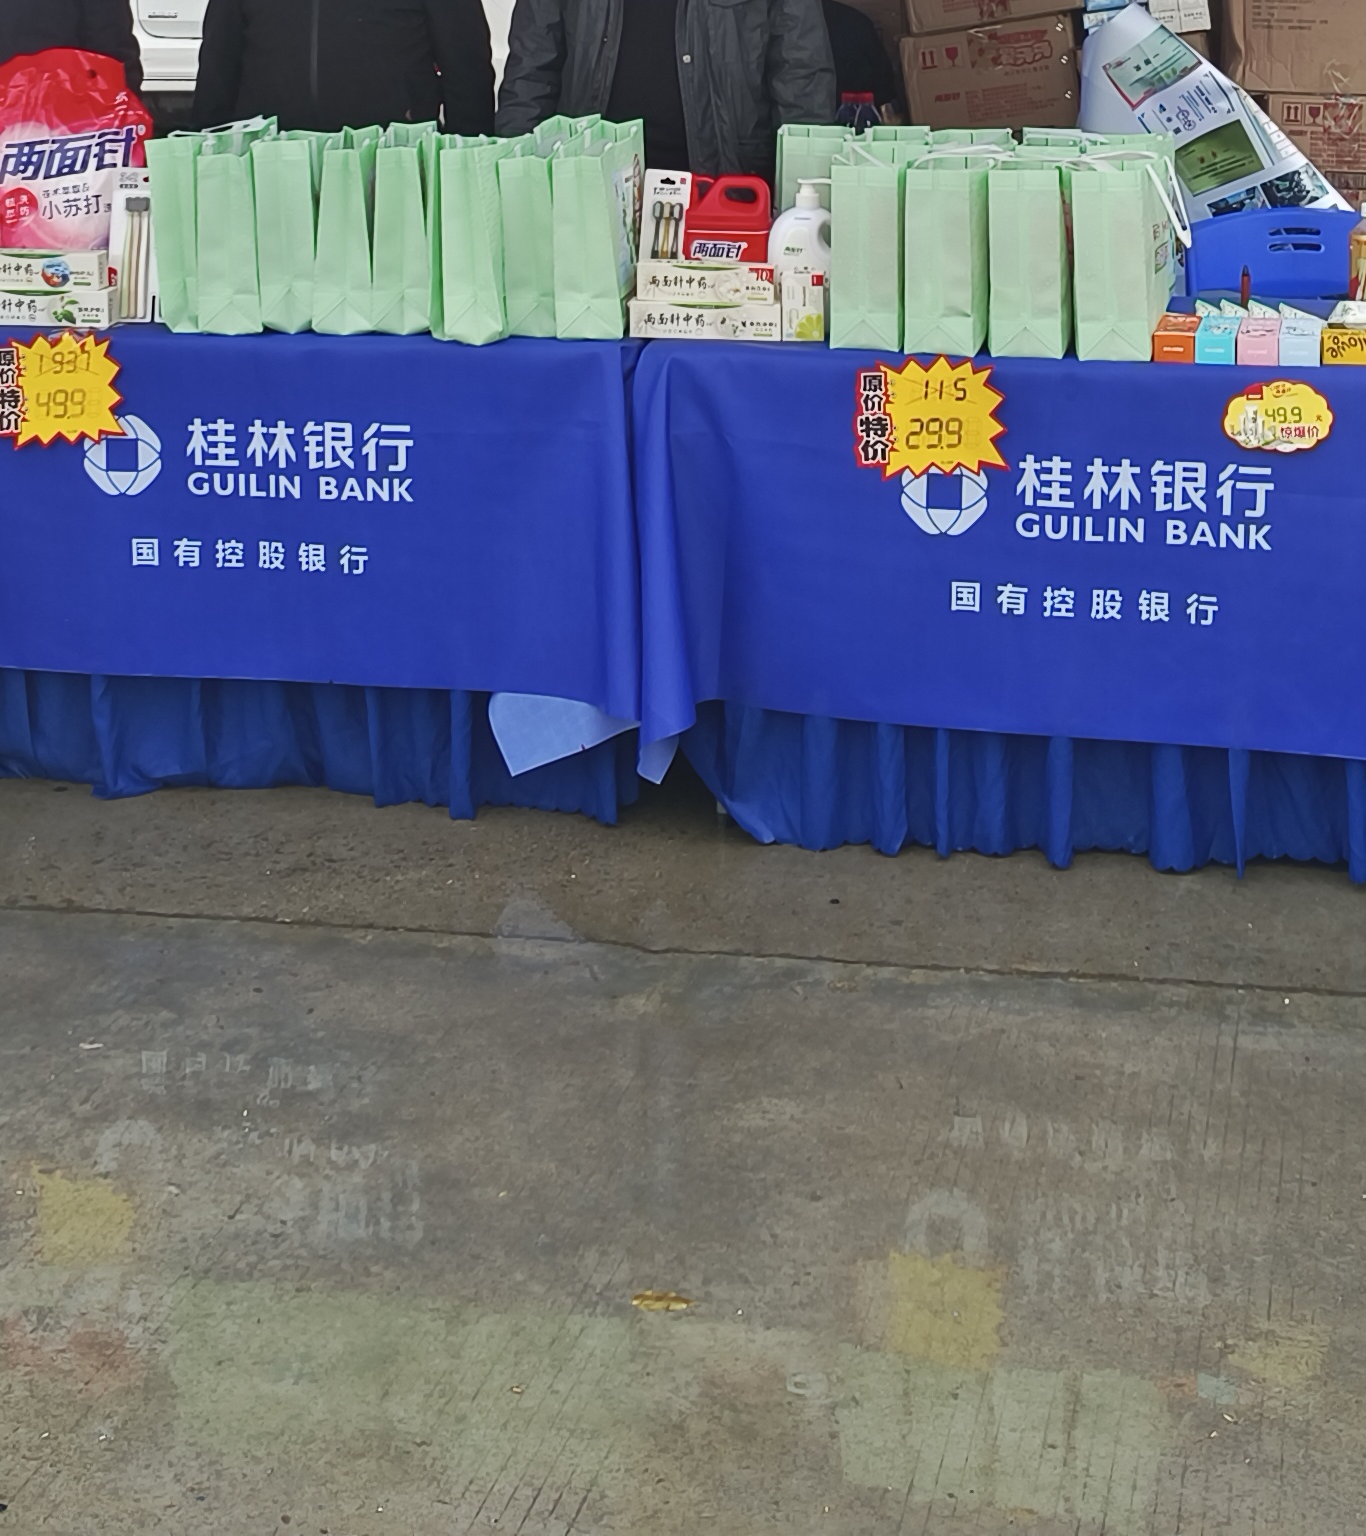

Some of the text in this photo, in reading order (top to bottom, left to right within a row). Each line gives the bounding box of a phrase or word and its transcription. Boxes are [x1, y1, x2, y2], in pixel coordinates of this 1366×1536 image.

[42, 194, 103, 220] 小苏打
[692, 240, 748, 259] 两面针
[862, 374, 967, 412] 原价 115
[1264, 406, 1303, 424] 49.9
[1280, 425, 1320, 439] 惊爆价
[185, 417, 416, 473] 桂林银行
[859, 416, 963, 462] 特价 29.9
[187, 472, 415, 504] GUILIN BANK
[1015, 454, 1276, 517] 桂林银行
[1015, 512, 1274, 553] GUILIN BANK
[131, 537, 370, 575] 国有控股银行
[951, 581, 1221, 626] 国有控股银行
